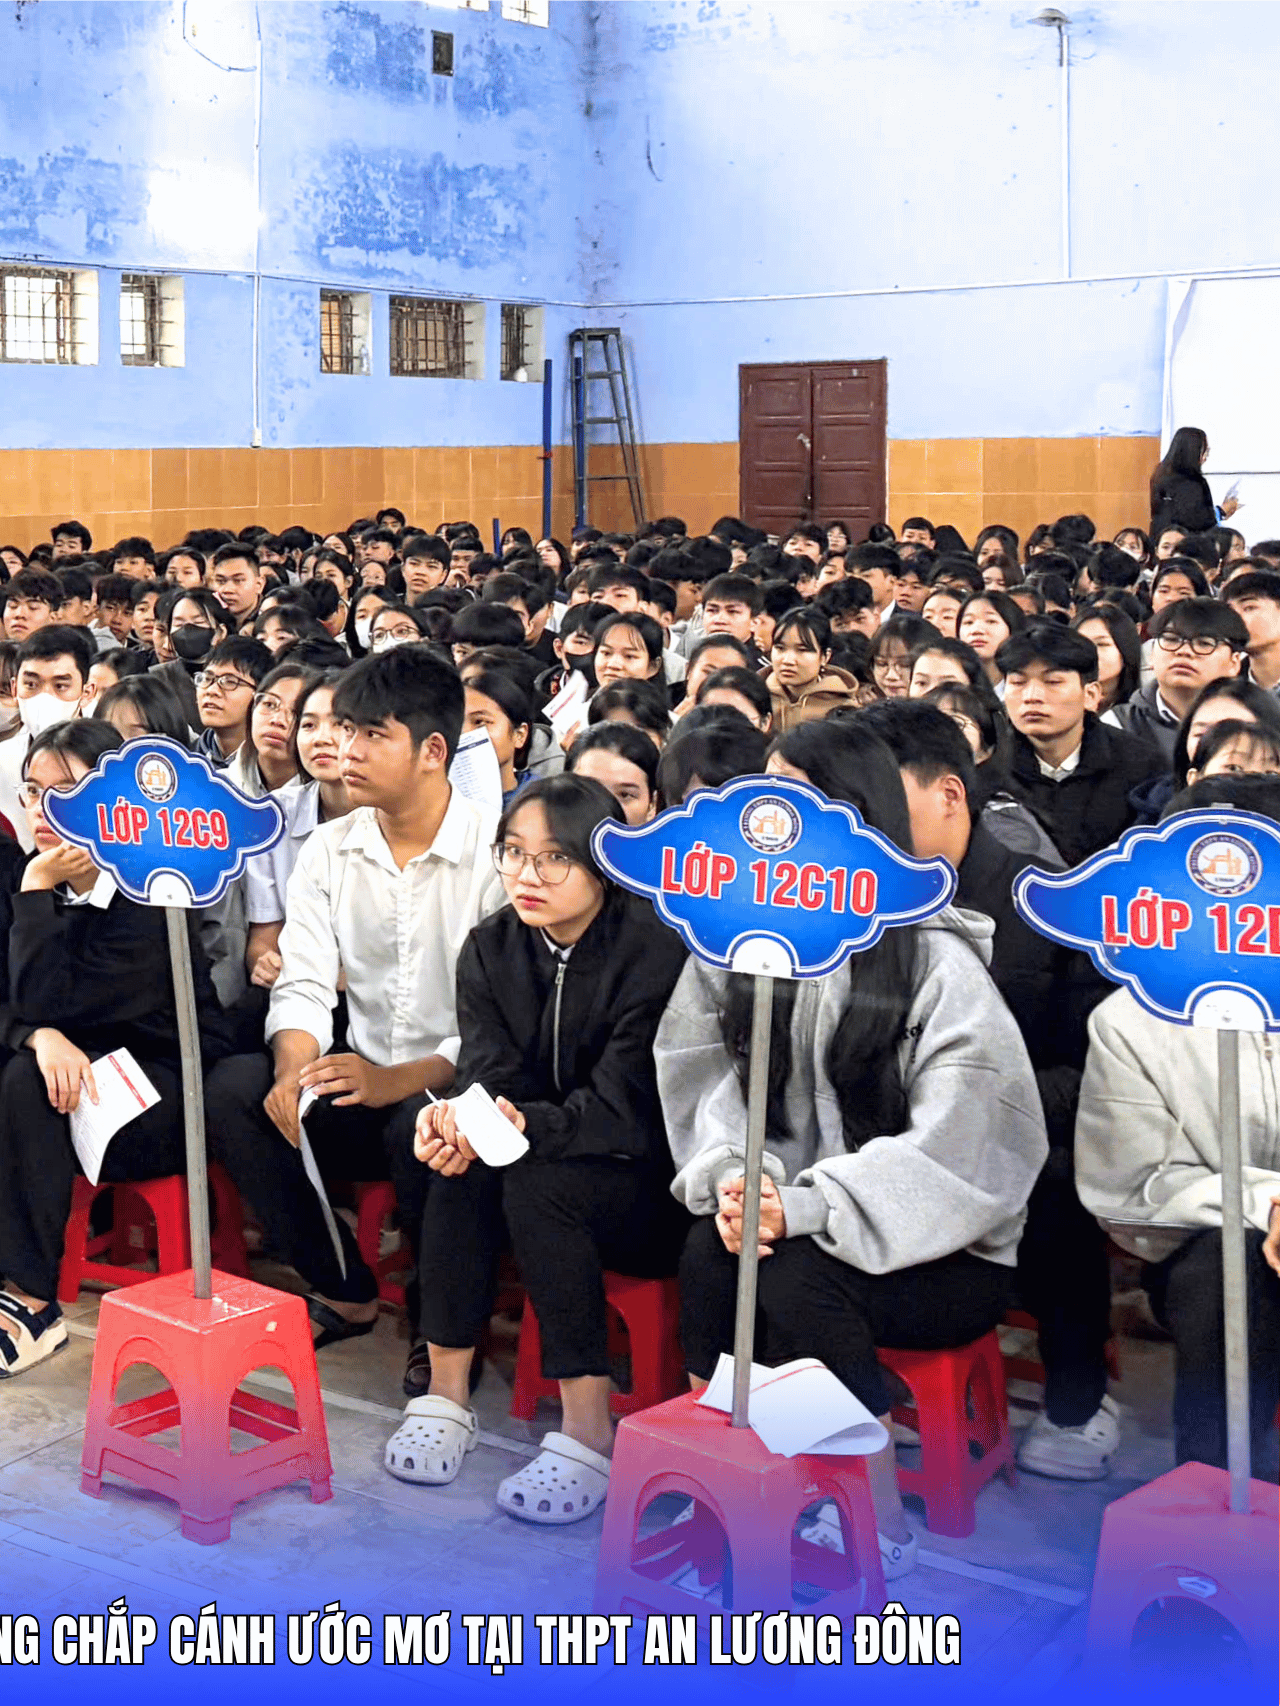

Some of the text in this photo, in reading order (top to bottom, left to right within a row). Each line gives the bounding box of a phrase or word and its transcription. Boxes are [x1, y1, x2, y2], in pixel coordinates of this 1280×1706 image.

[97, 796, 230, 850] LỚP 12C9
[661, 841, 878, 917] LỚP 12C10
[1102, 887, 1192, 950] LỚP
